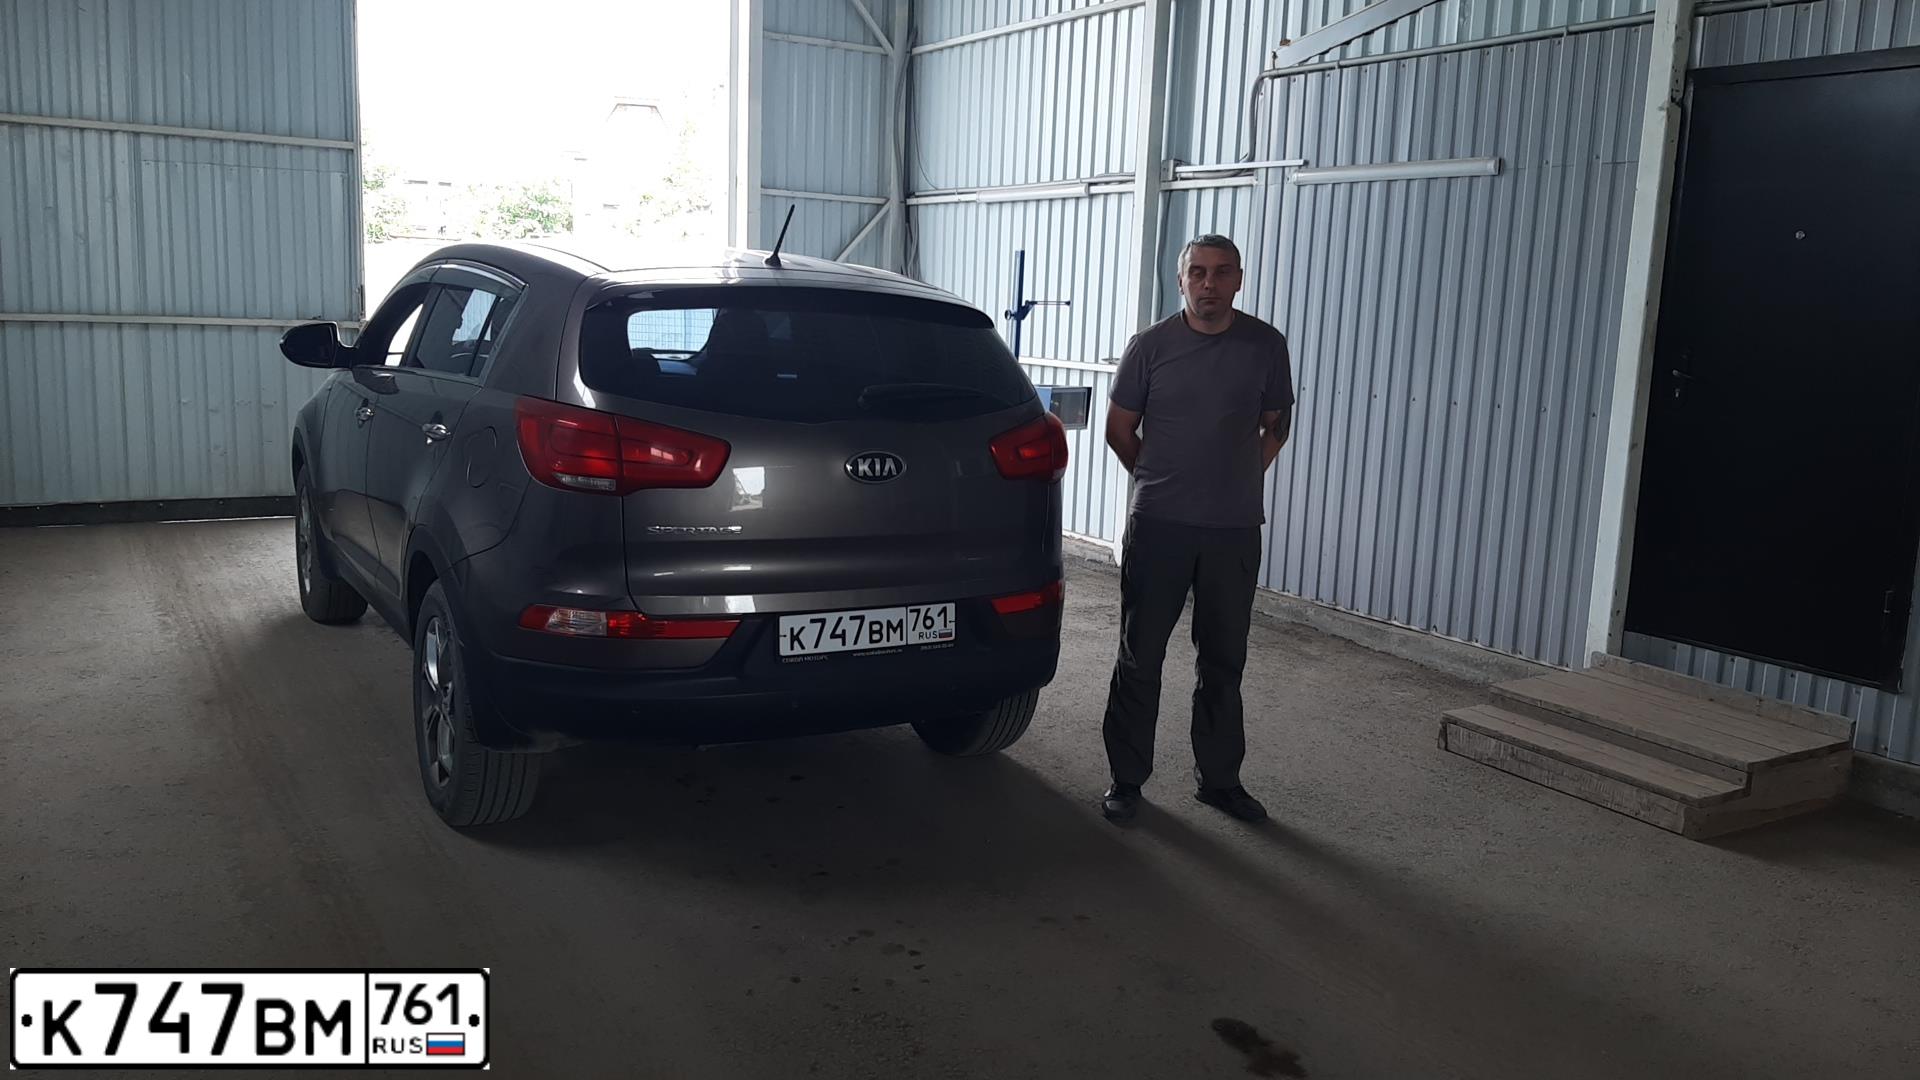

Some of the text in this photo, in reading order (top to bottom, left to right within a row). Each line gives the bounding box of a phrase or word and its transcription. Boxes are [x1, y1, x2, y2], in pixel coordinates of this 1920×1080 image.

[857, 457, 897, 477] KIA
[909, 606, 948, 632] 761
[918, 631, 938, 641] RUS
